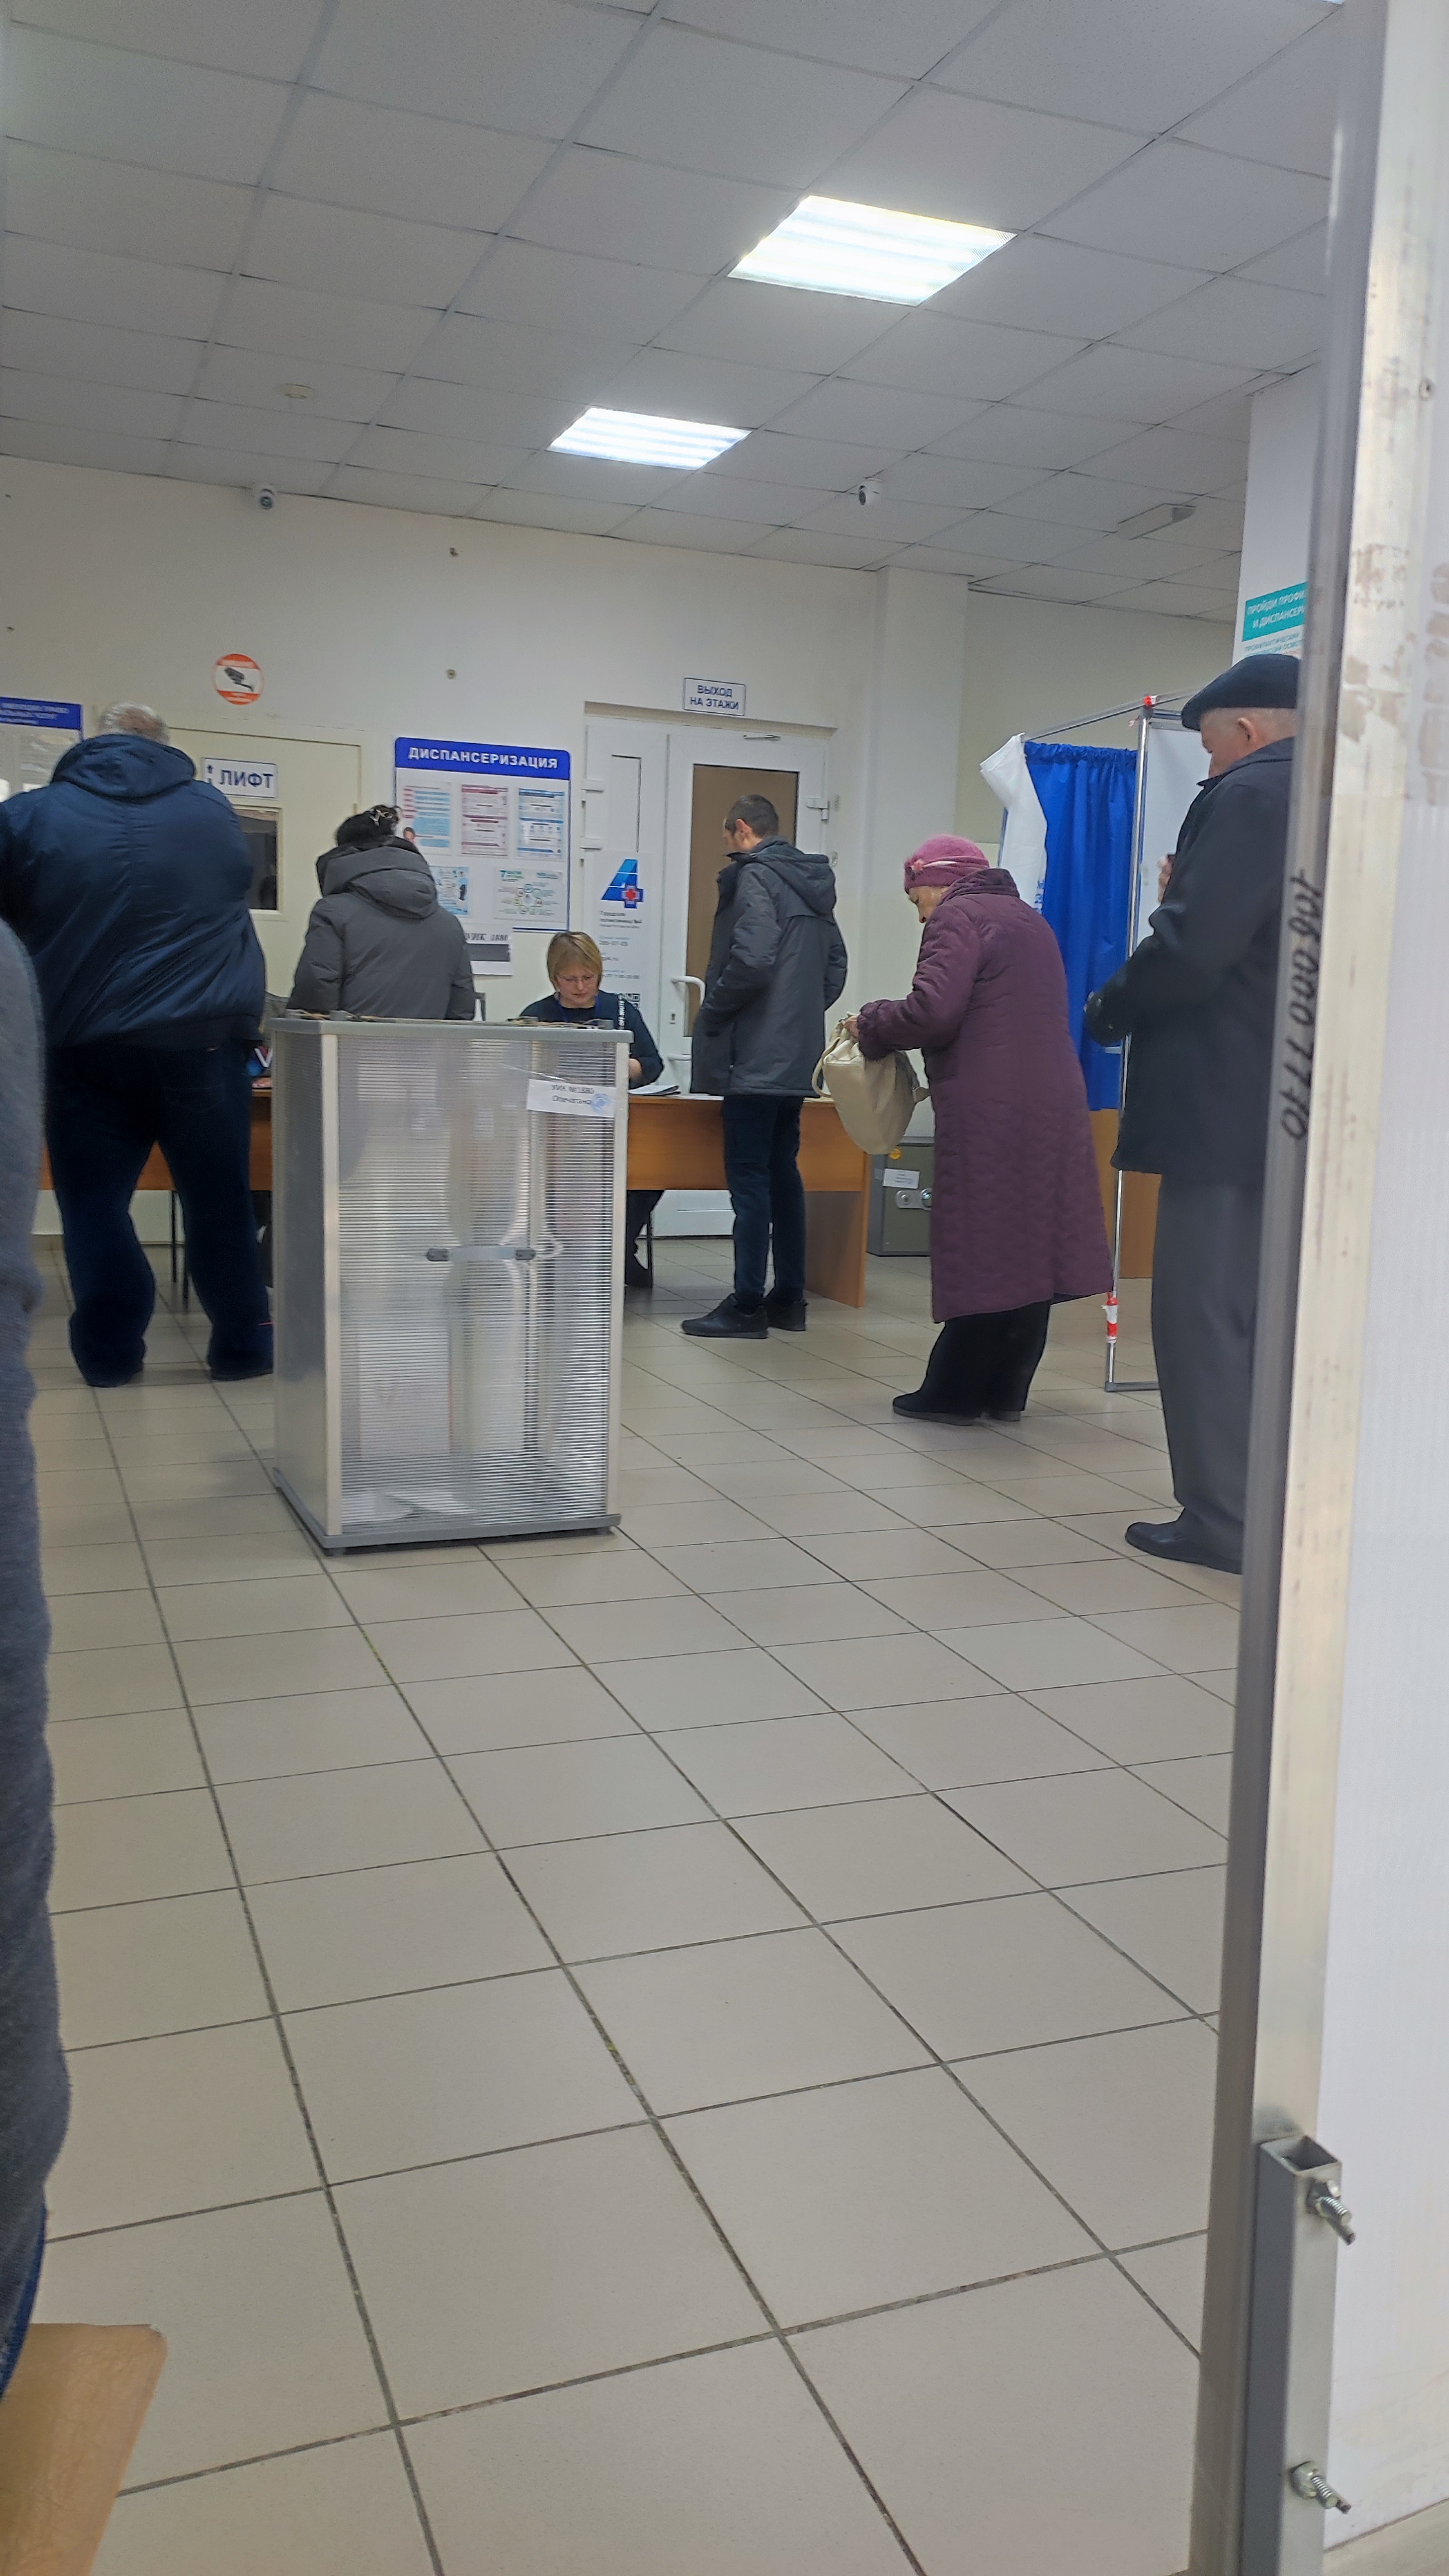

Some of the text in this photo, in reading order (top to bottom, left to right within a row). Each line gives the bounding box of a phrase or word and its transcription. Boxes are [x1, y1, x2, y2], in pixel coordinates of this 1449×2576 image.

[1247, 590, 1306, 615] ПРОЙДИ ПРОФИ
[1253, 619, 1259, 629] И
[697, 685, 733, 698] ВЫХОД
[690, 697, 739, 710] НА ЭТАЖИ
[408, 747, 558, 769] ДИСПАНСЕРИЗАЦИЯ
[219, 769, 274, 789] ЛИФТ
